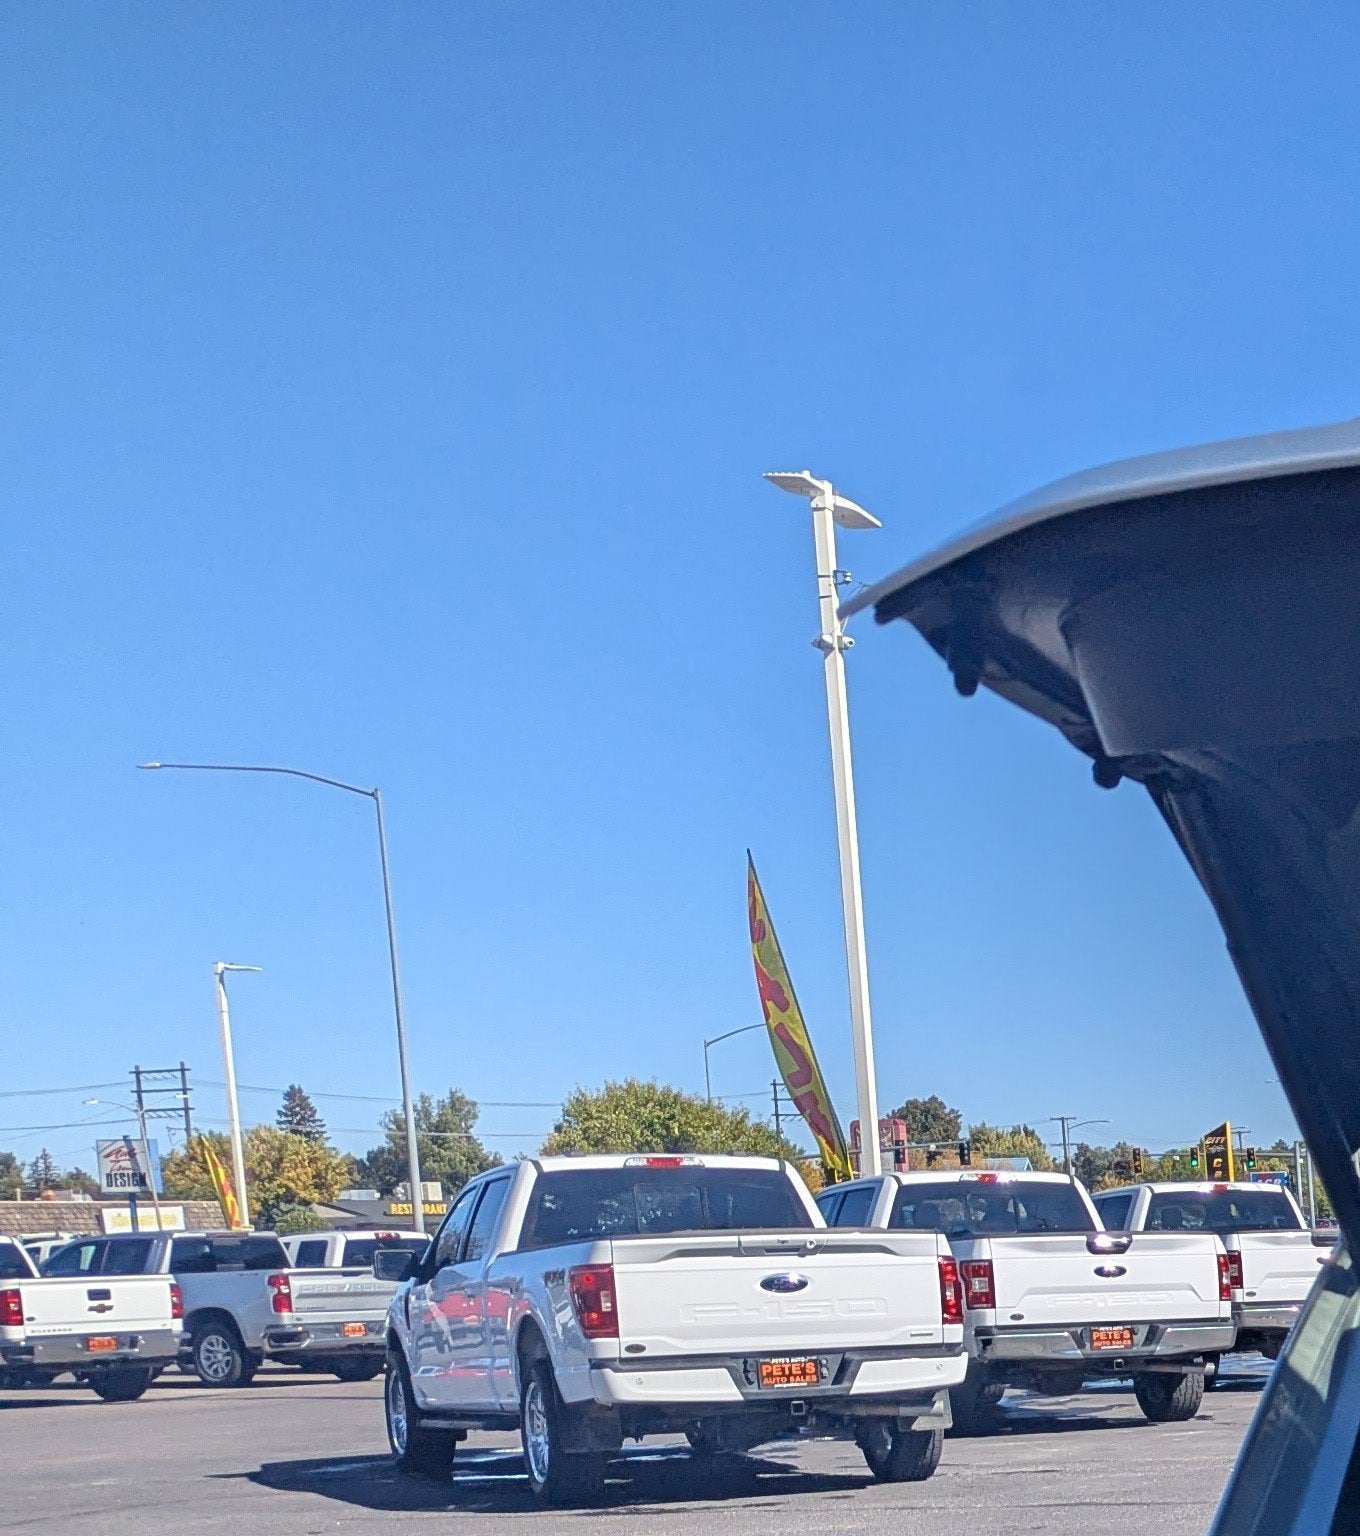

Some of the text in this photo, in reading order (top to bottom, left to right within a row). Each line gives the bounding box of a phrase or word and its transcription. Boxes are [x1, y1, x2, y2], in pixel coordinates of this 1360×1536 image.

[105, 1172, 147, 1188] DESIGN
[390, 1203, 448, 1215] RESTRANT
[680, 1298, 887, 1323] F-150
[1092, 1330, 1131, 1341] PETE'S
[761, 1362, 816, 1376] PETE'S
[763, 1376, 788, 1385] AUTO
[789, 1374, 817, 1383] SALES
